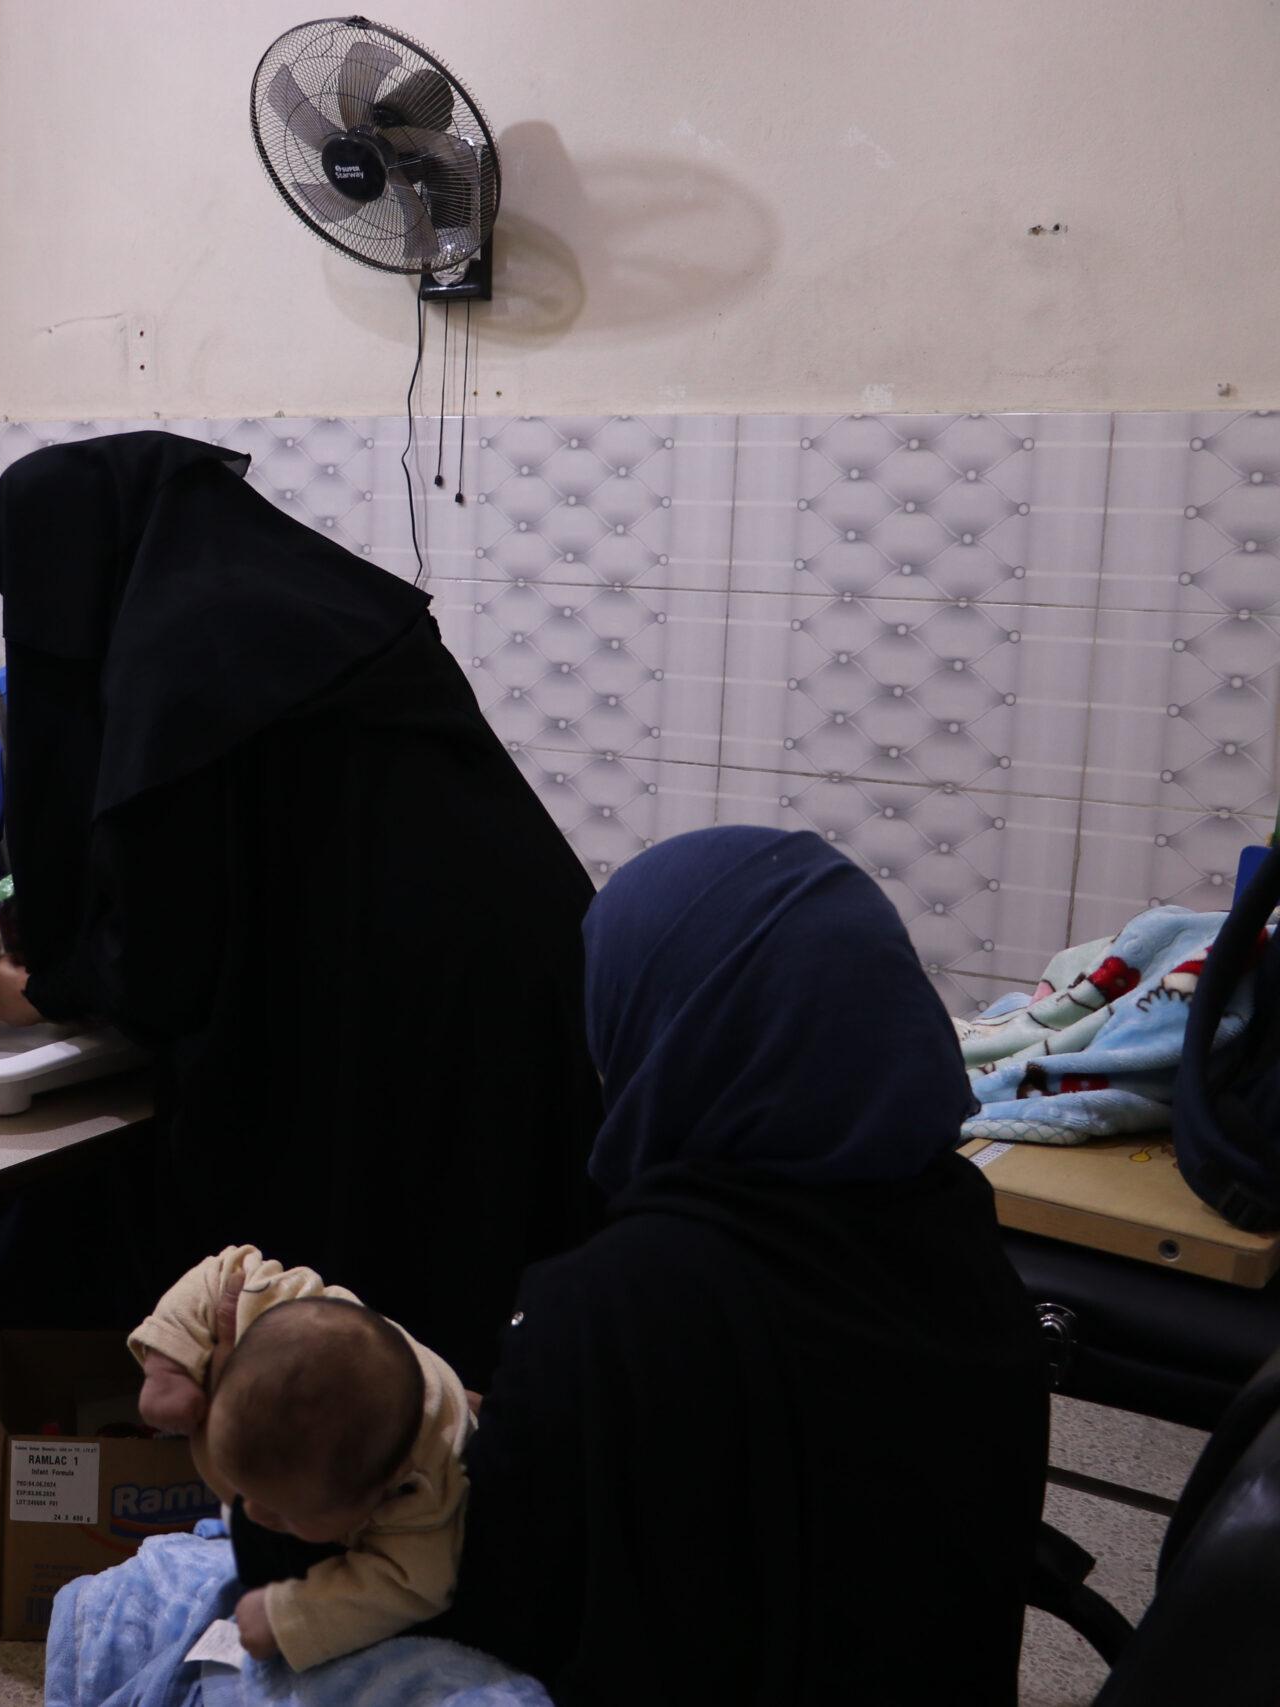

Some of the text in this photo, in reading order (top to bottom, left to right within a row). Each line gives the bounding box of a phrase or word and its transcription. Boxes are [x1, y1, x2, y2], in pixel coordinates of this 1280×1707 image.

[28, 1454, 78, 1466] RAMLAC 1
[31, 1468, 49, 1476] Infant
